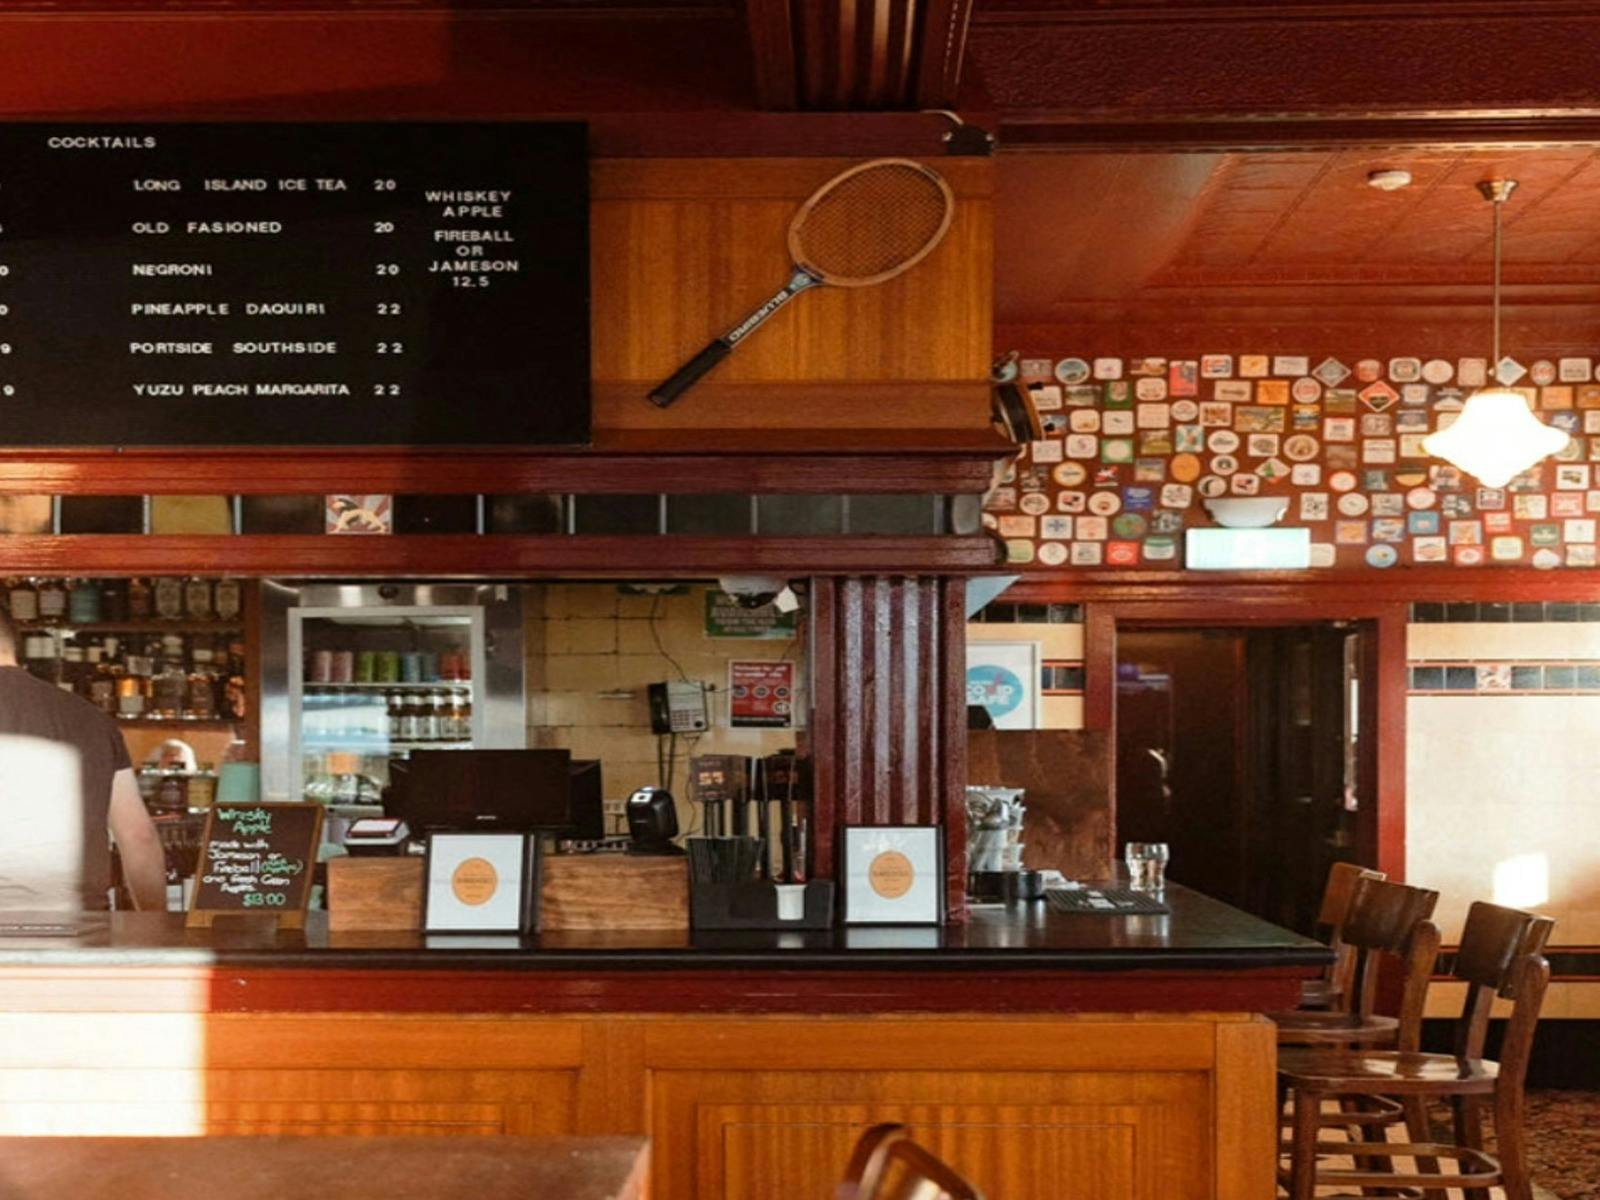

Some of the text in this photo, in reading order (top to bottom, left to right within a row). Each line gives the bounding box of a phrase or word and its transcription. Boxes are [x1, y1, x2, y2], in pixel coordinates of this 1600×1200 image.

[47, 136, 156, 149] COCKTAILS
[133, 178, 397, 192] LONG ISLAND ICE TEA 20
[425, 190, 512, 203] WHISKEY
[442, 205, 503, 218] APPLE
[132, 221, 395, 234] OLD FASIONED 20
[434, 229, 514, 242] FIREBALL
[455, 245, 484, 257] OR
[132, 263, 400, 277] NEGRONI 20
[428, 260, 519, 273] JAMESON
[452, 275, 489, 288] 12.5
[131, 302, 230, 316] PINEAPPLE
[377, 302, 401, 316] 22
[129, 341, 403, 355] PORTSIDE SOUTHSIDE 22
[133, 383, 401, 397] YUZU PEACH MARGARITA 22
